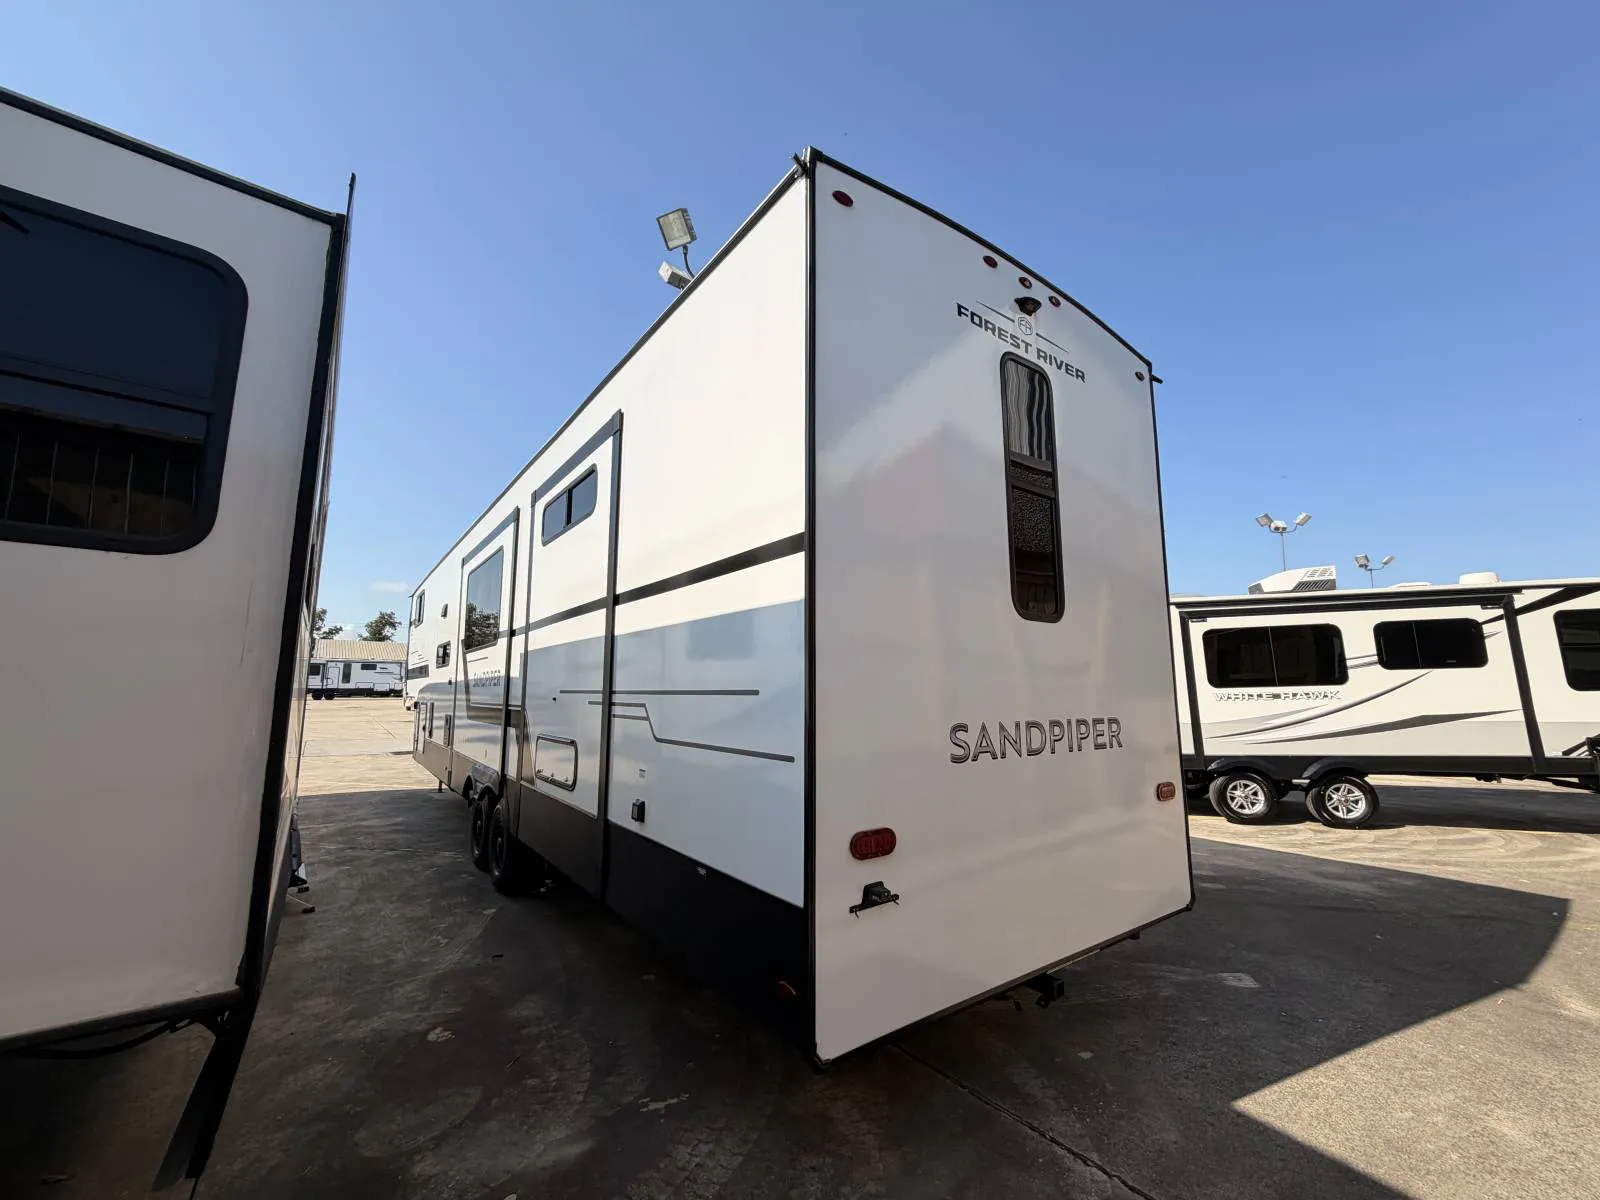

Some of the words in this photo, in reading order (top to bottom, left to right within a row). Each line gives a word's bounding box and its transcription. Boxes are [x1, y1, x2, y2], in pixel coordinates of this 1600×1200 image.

[956, 302, 1033, 355] FOREST
[1036, 346, 1086, 384] RIVER
[1215, 692, 1274, 702] WHITE
[1279, 690, 1343, 701] HAWK
[949, 716, 1123, 764] SANDPIPER
